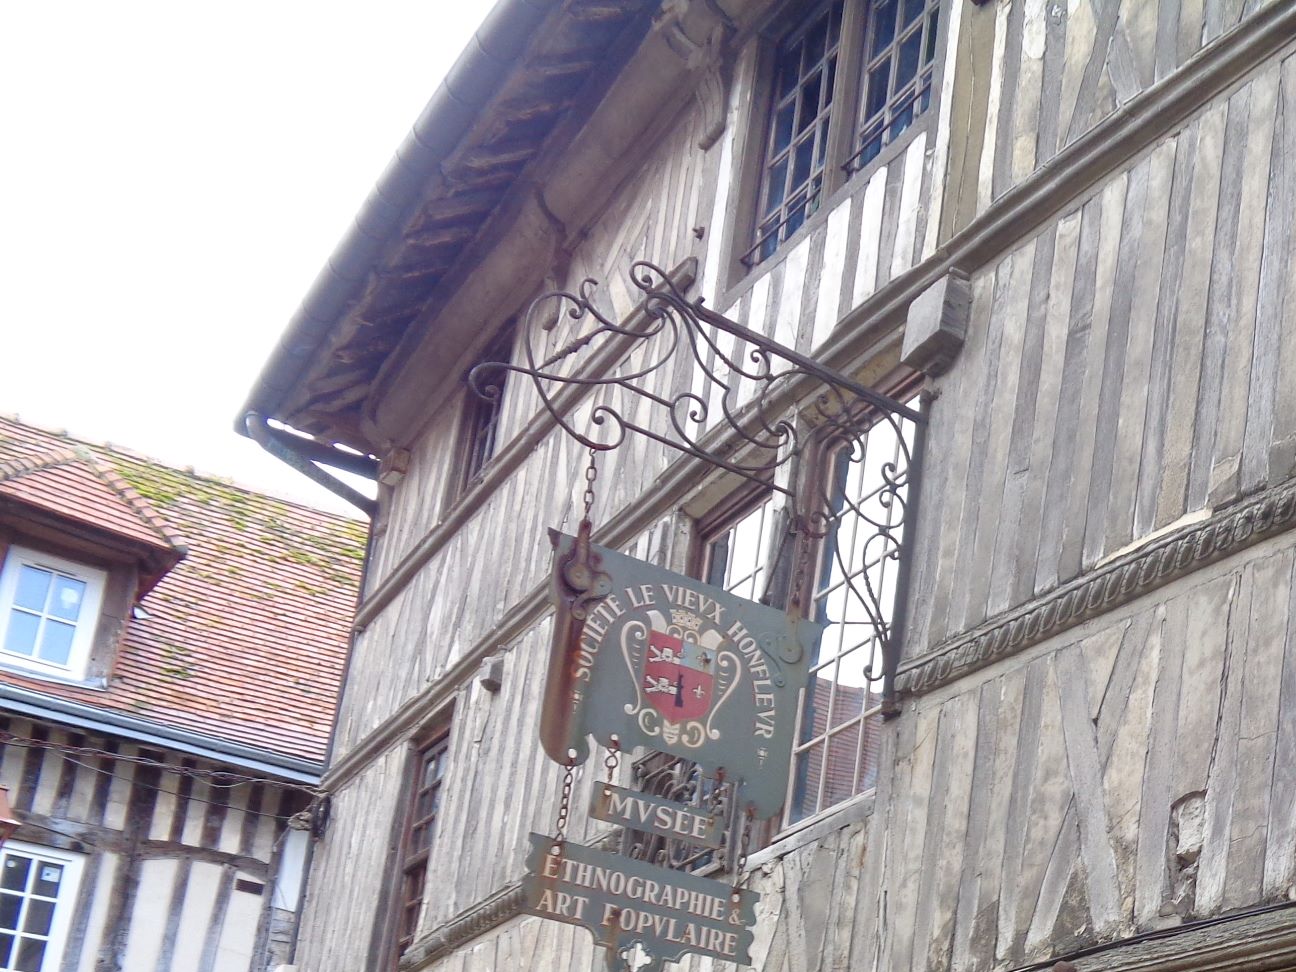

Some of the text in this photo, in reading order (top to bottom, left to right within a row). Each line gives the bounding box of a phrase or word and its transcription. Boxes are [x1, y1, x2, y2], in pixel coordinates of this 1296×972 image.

[625, 584, 656, 608] LE
[661, 583, 727, 625] VIEVX
[727, 620, 776, 739] HONFLEVR
[535, 888, 590, 919] ART
[542, 854, 746, 926] ETHNOGRAPHIE &
